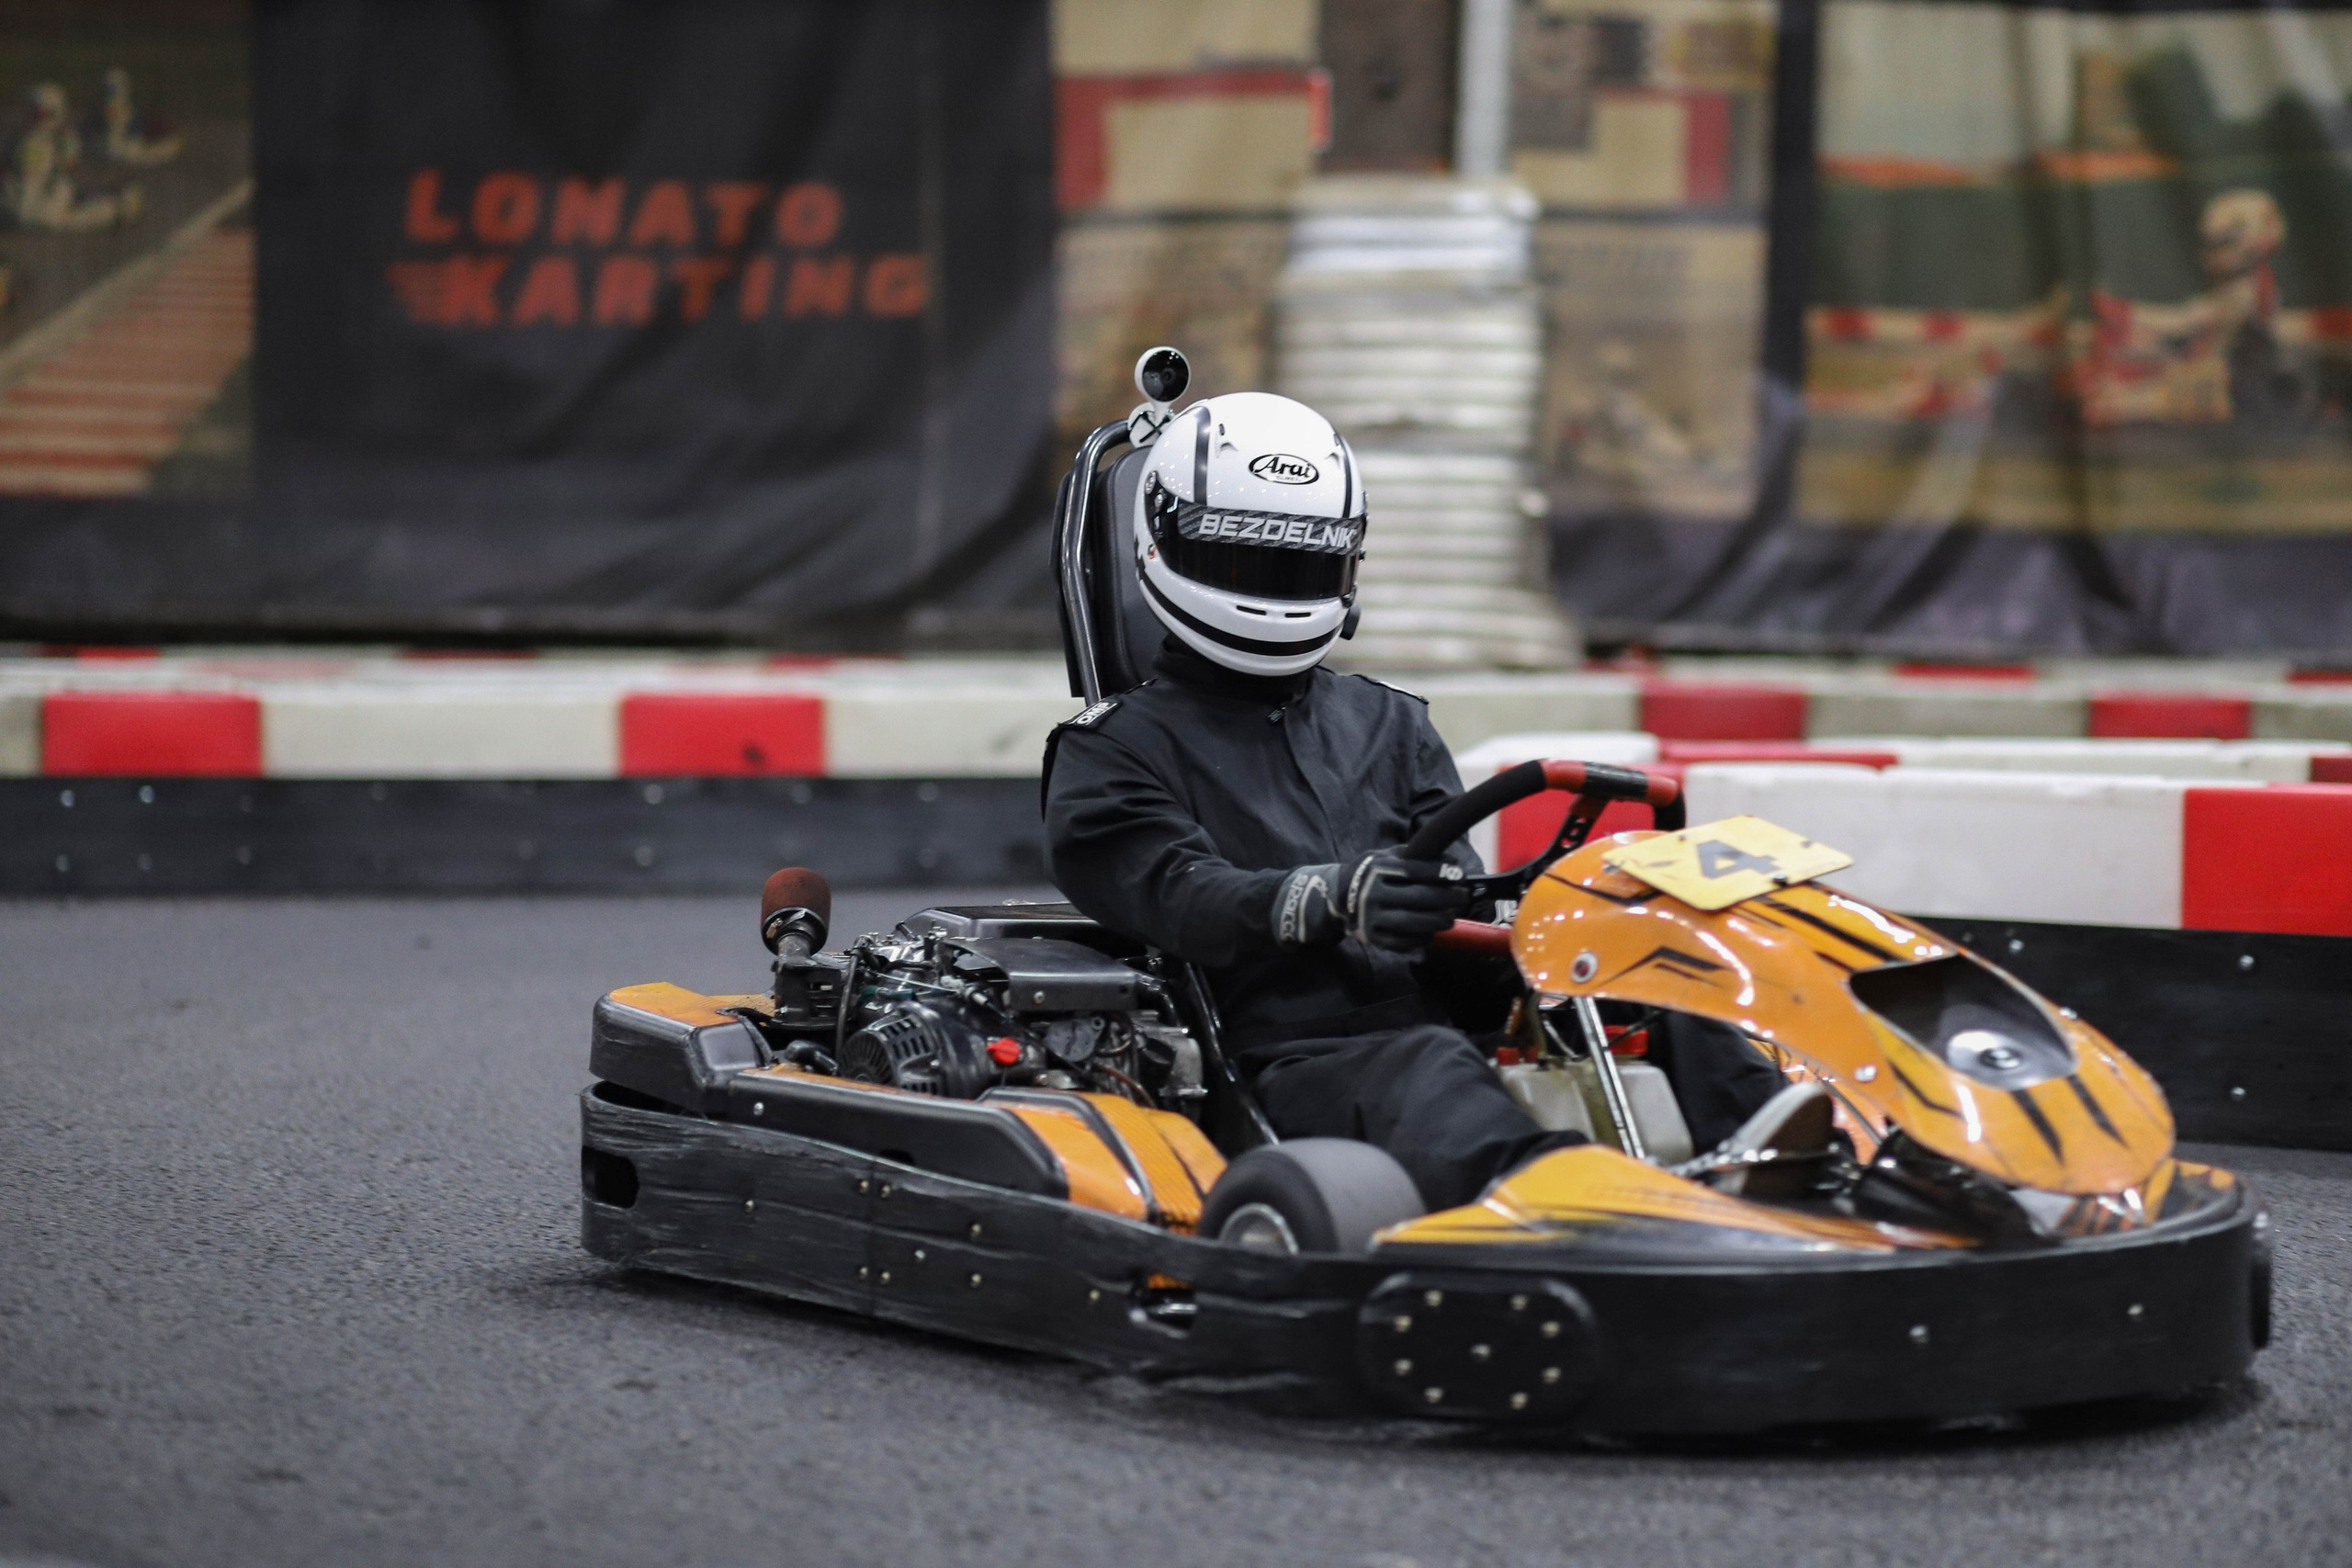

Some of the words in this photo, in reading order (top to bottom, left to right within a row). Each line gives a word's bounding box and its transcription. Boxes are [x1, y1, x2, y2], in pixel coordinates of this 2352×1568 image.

[435, 254, 930, 327] KARTING
[1254, 456, 1311, 478] Arai
[1198, 513, 1356, 548] BEZDELNIK
[1076, 702, 1110, 725] OMP
[1696, 840, 1781, 880] 4
